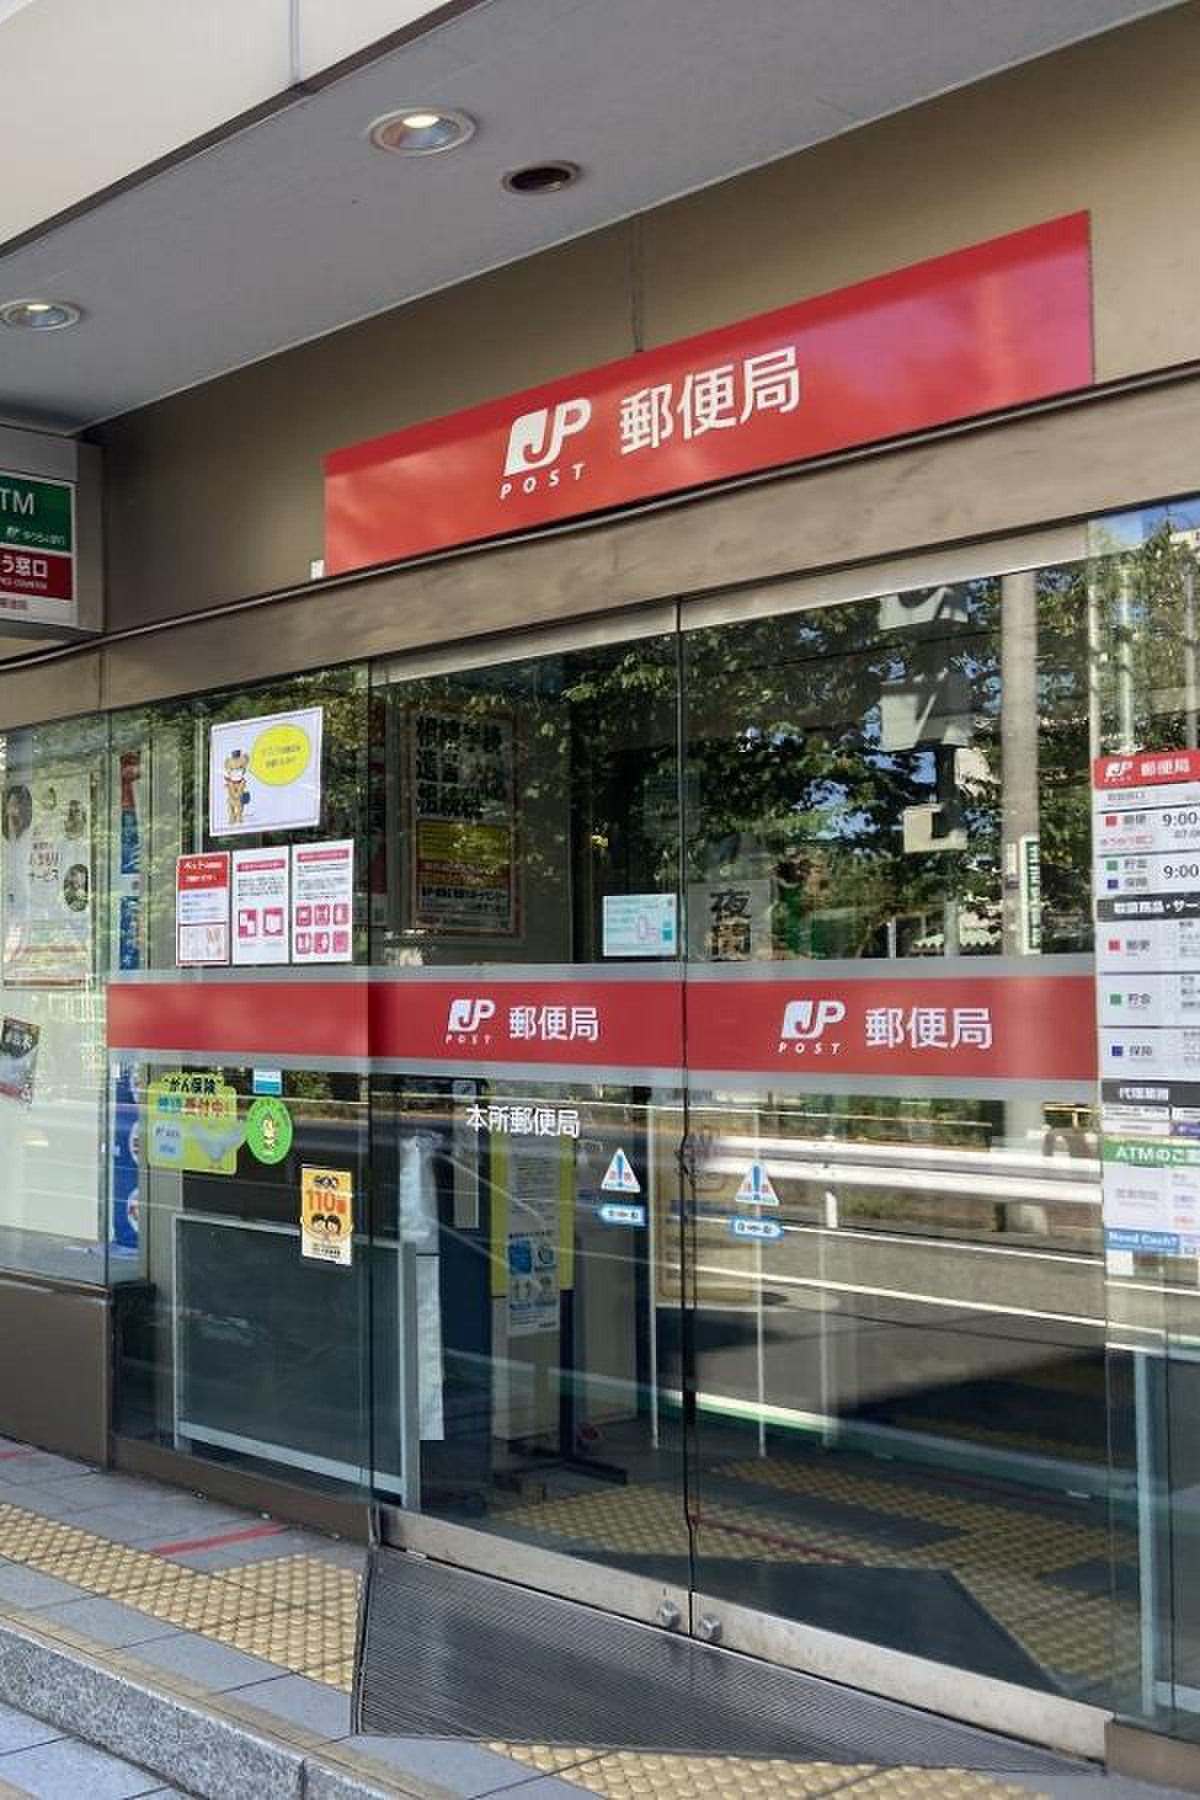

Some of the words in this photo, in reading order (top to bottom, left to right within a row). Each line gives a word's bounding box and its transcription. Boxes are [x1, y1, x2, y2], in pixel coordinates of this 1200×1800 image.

[618, 345, 800, 455] 郵便局
[502, 397, 592, 477] JP
[499, 462, 585, 500] POST
[1162, 811, 1198, 827] 9:00
[1163, 864, 1199, 879] 9:00
[447, 999, 496, 1032] JP
[509, 1006, 600, 1042] 郵便局
[781, 1000, 846, 1039] JP
[865, 1007, 993, 1050] 郵便局
[446, 1034, 492, 1044] POST
[777, 1042, 840, 1054] POST
[465, 1104, 580, 1138] 本所郵便局
